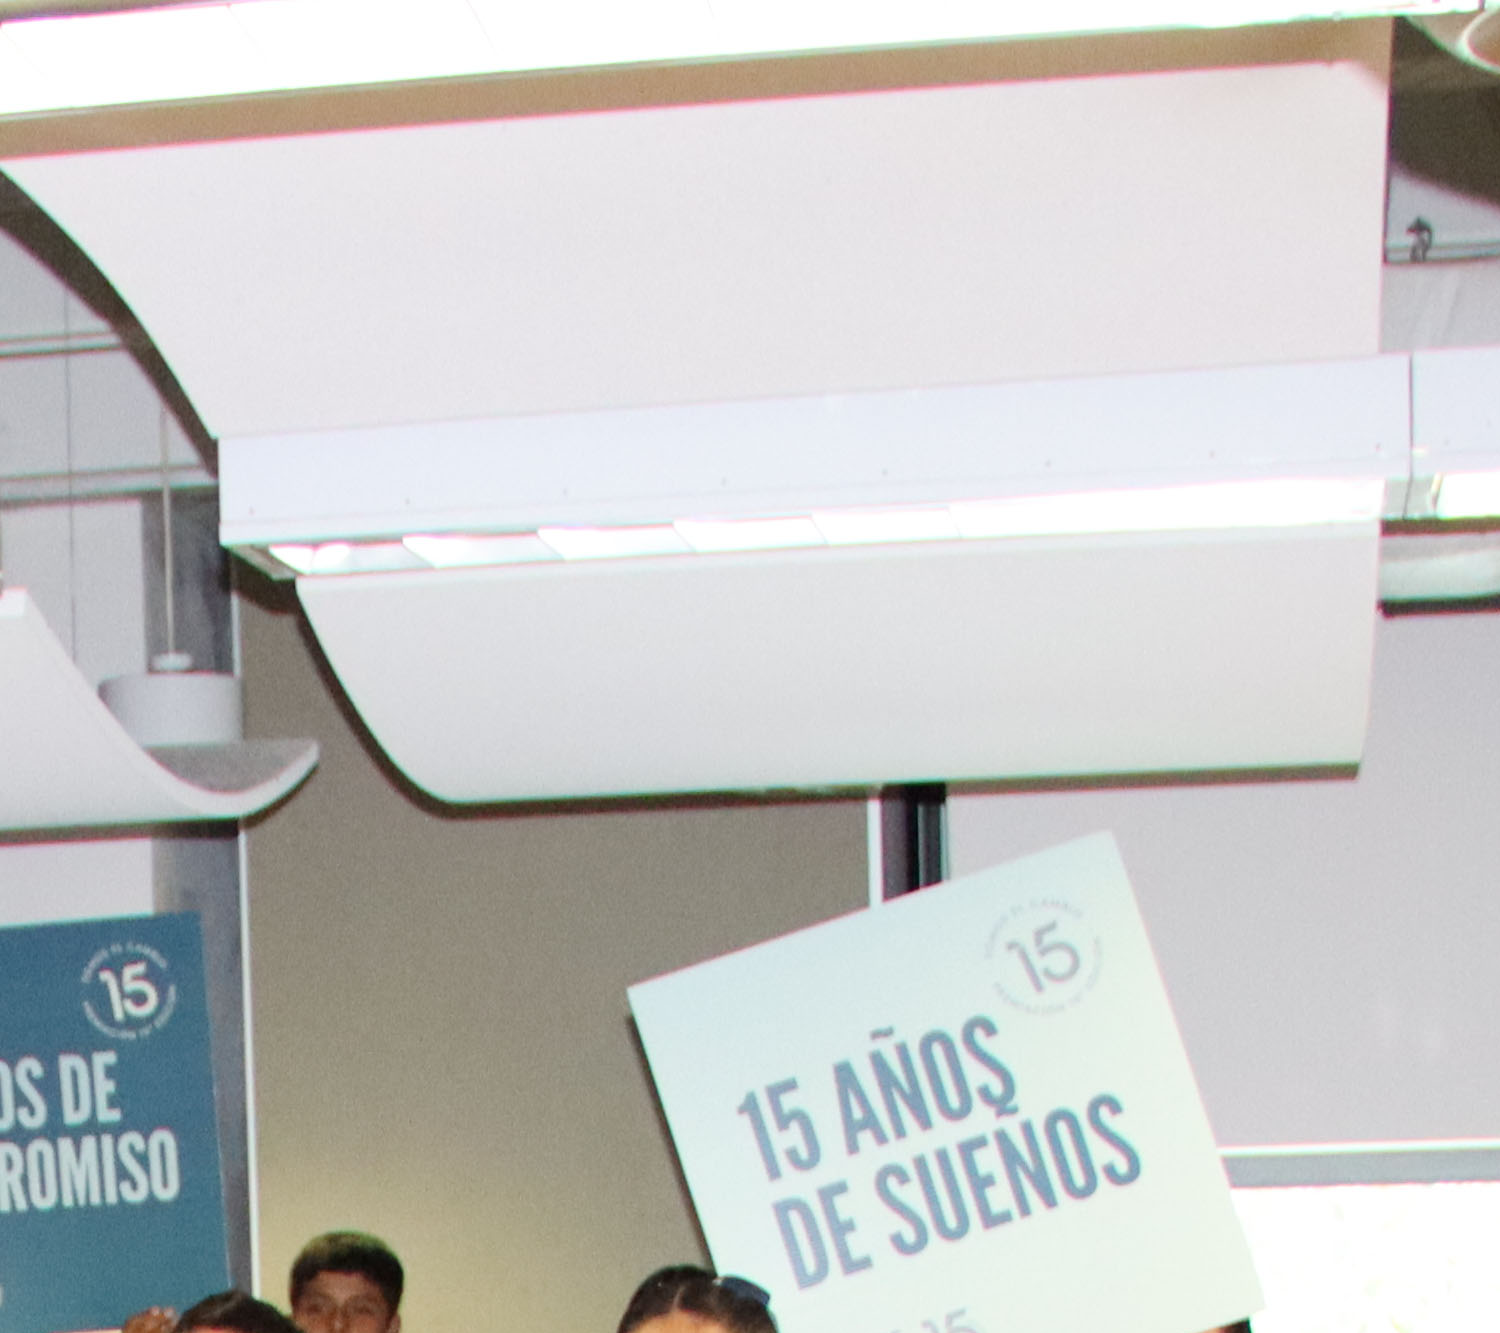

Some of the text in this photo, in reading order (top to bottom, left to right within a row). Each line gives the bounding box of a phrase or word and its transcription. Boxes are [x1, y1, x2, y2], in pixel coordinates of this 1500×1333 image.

[99, 961, 158, 1021] 15
[1006, 920, 1080, 993] 15
[58, 1051, 122, 1126] DE
[737, 1015, 1018, 1181] 15 AÑOS
[772, 1094, 1142, 1291] DE SUEÑOS
